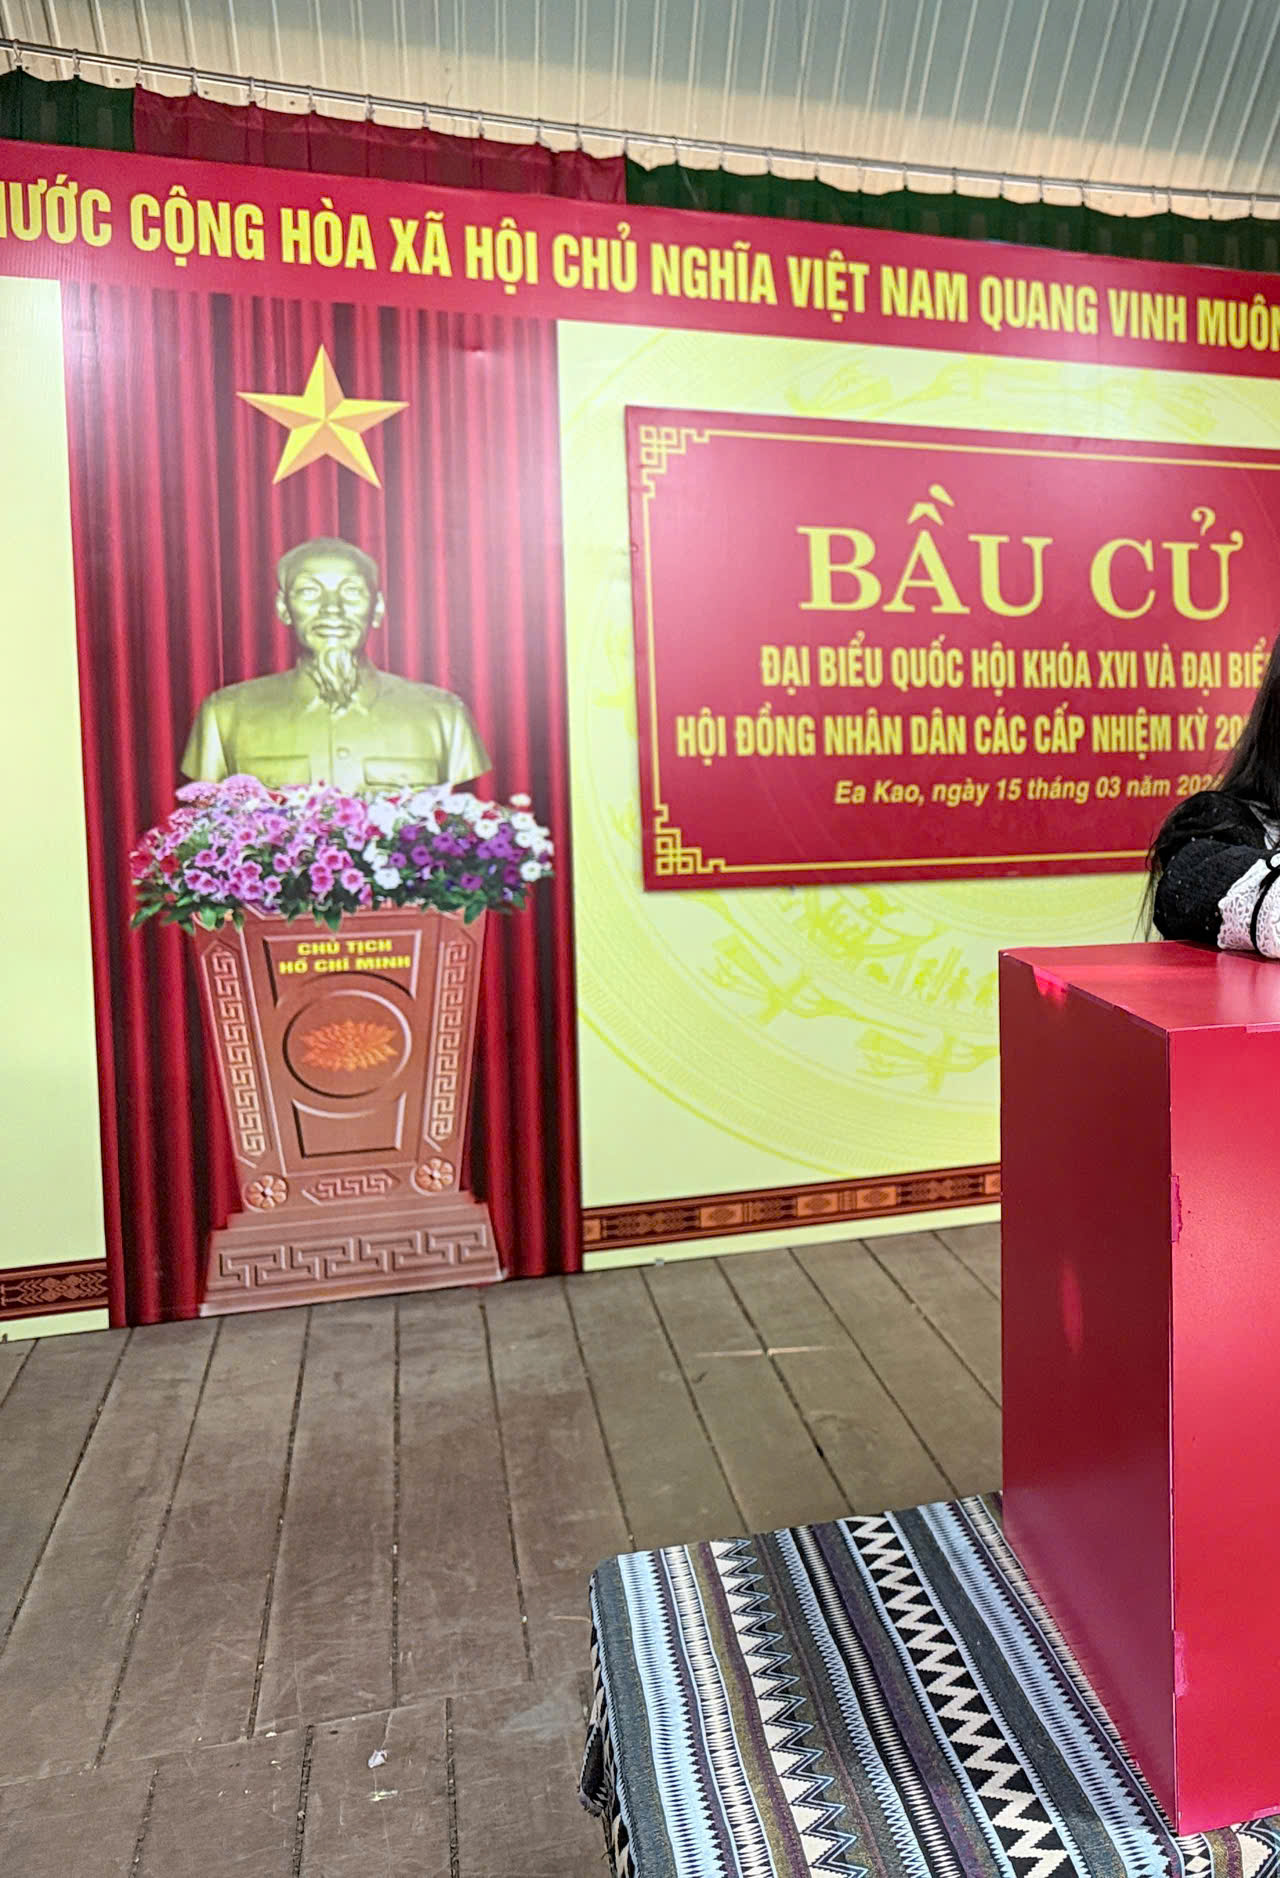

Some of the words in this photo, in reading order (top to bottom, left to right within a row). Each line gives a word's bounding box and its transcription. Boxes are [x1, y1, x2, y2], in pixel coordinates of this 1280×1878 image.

[131, 186, 264, 266] CỘNG
[281, 198, 376, 269] HÒA
[390, 211, 452, 276] XÃ
[465, 218, 538, 295] HỘI
[552, 224, 636, 292] CHỦ
[651, 242, 776, 304] NGHĨA
[787, 252, 869, 322] VIỆT
[881, 266, 968, 320] NAM
[980, 276, 1097, 333] QUANG
[1109, 289, 1186, 342] VINH
[798, 485, 1053, 617] BẦU
[1090, 506, 1243, 620] CỬ
[762, 646, 810, 696] ĐẠI
[819, 632, 882, 686] BIỂU
[892, 634, 963, 691] QUỐC
[972, 642, 1015, 696] HỘI
[1024, 644, 1091, 688] KHÓA
[1099, 652, 1137, 688] XVI
[1145, 642, 1175, 688] VÀ
[1182, 652, 1221, 696] ĐẠI
[1228, 636, 1270, 688] BIỂ
[677, 708, 725, 765] HỘI
[736, 702, 815, 756] ĐỒNG
[824, 709, 902, 755] NHÂN
[911, 708, 966, 754] DÂN
[975, 705, 1026, 754] CÁC
[1035, 704, 1084, 757] CẤP
[1092, 709, 1171, 761] NHIỆM
[1179, 706, 1208, 750] KỲ
[836, 781, 865, 803] Ea
[874, 783, 923, 809] Kao,
[934, 781, 987, 806] ngày
[1000, 779, 1020, 800] 15
[1029, 773, 1088, 803] tháng
[1096, 777, 1120, 801] 03
[1128, 776, 1169, 800] năm
[278, 957, 309, 975] HỒ
[313, 956, 349, 973] CHÍ
[355, 955, 411, 971] MINH
[297, 937, 341, 956] CHỦ
[345, 938, 393, 956] TỊCH
